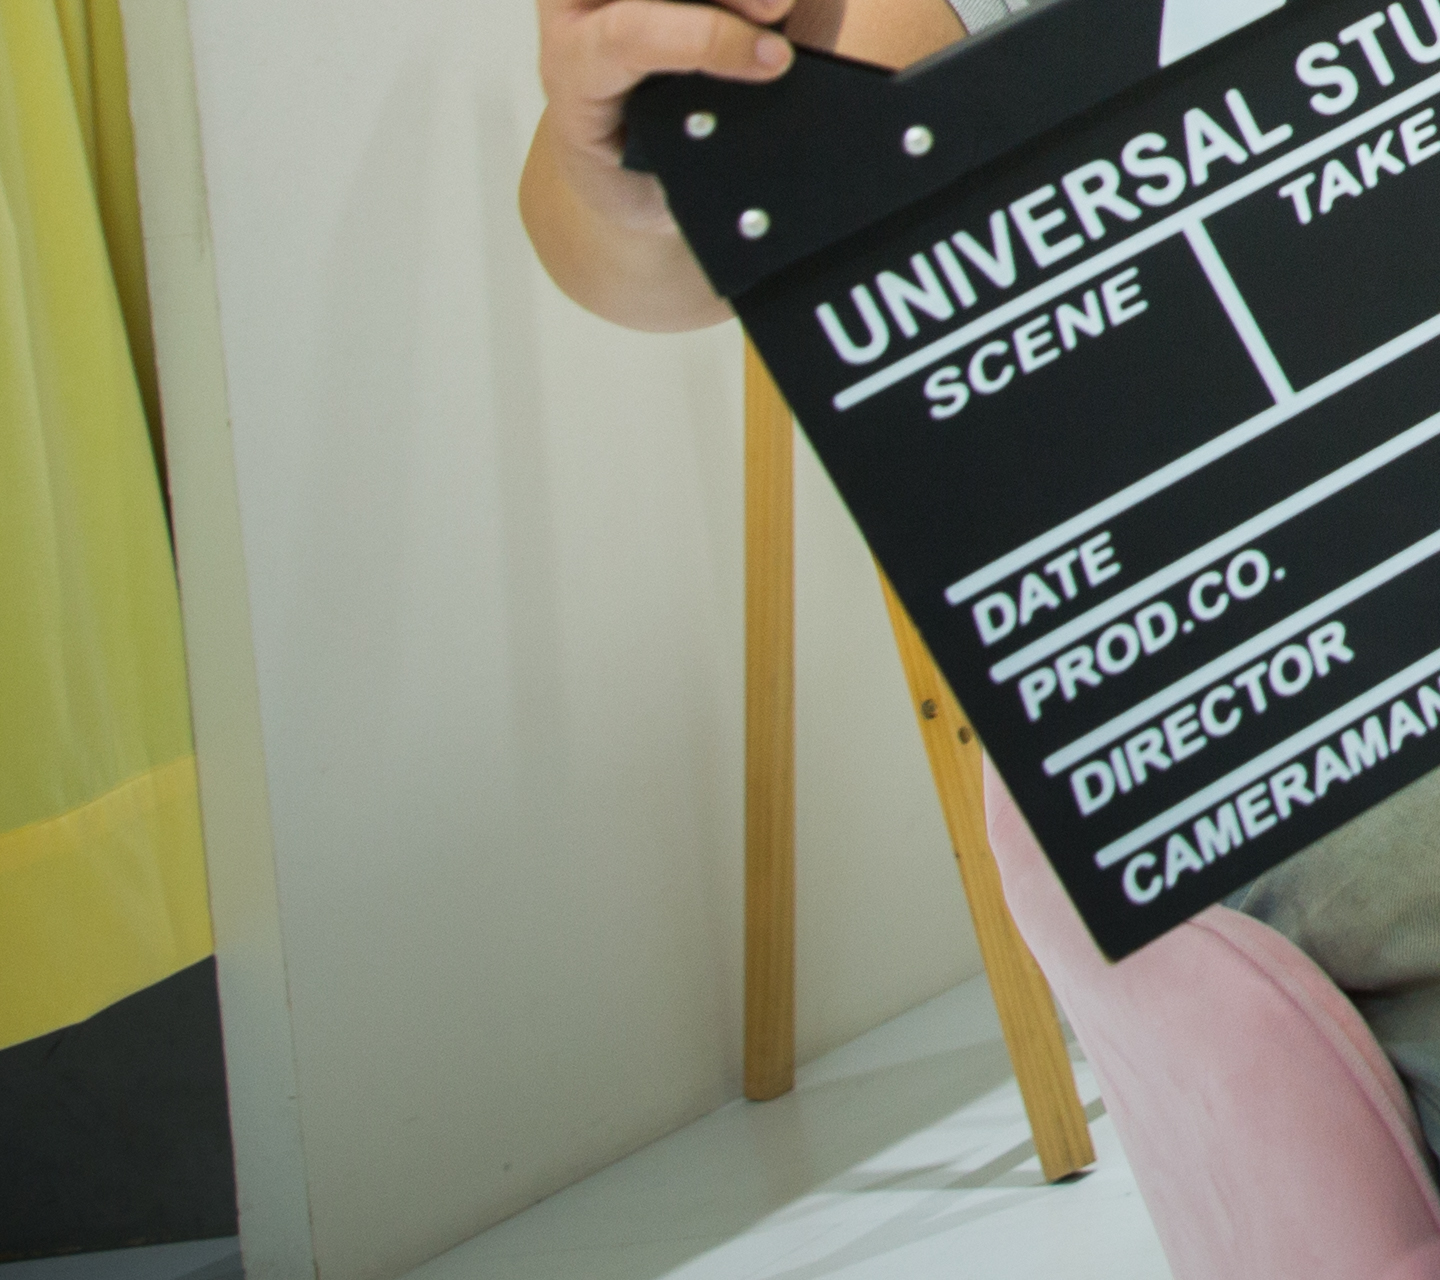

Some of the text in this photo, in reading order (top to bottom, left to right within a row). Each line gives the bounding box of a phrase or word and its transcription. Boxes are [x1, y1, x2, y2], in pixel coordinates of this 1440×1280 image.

[814, 87, 1295, 366] UNIVERSAL
[922, 265, 1149, 421] SCENE
[971, 530, 1122, 646] DATE
[1017, 549, 1286, 721] PROD.CO.
[1069, 620, 1355, 816] DIRECTOR
